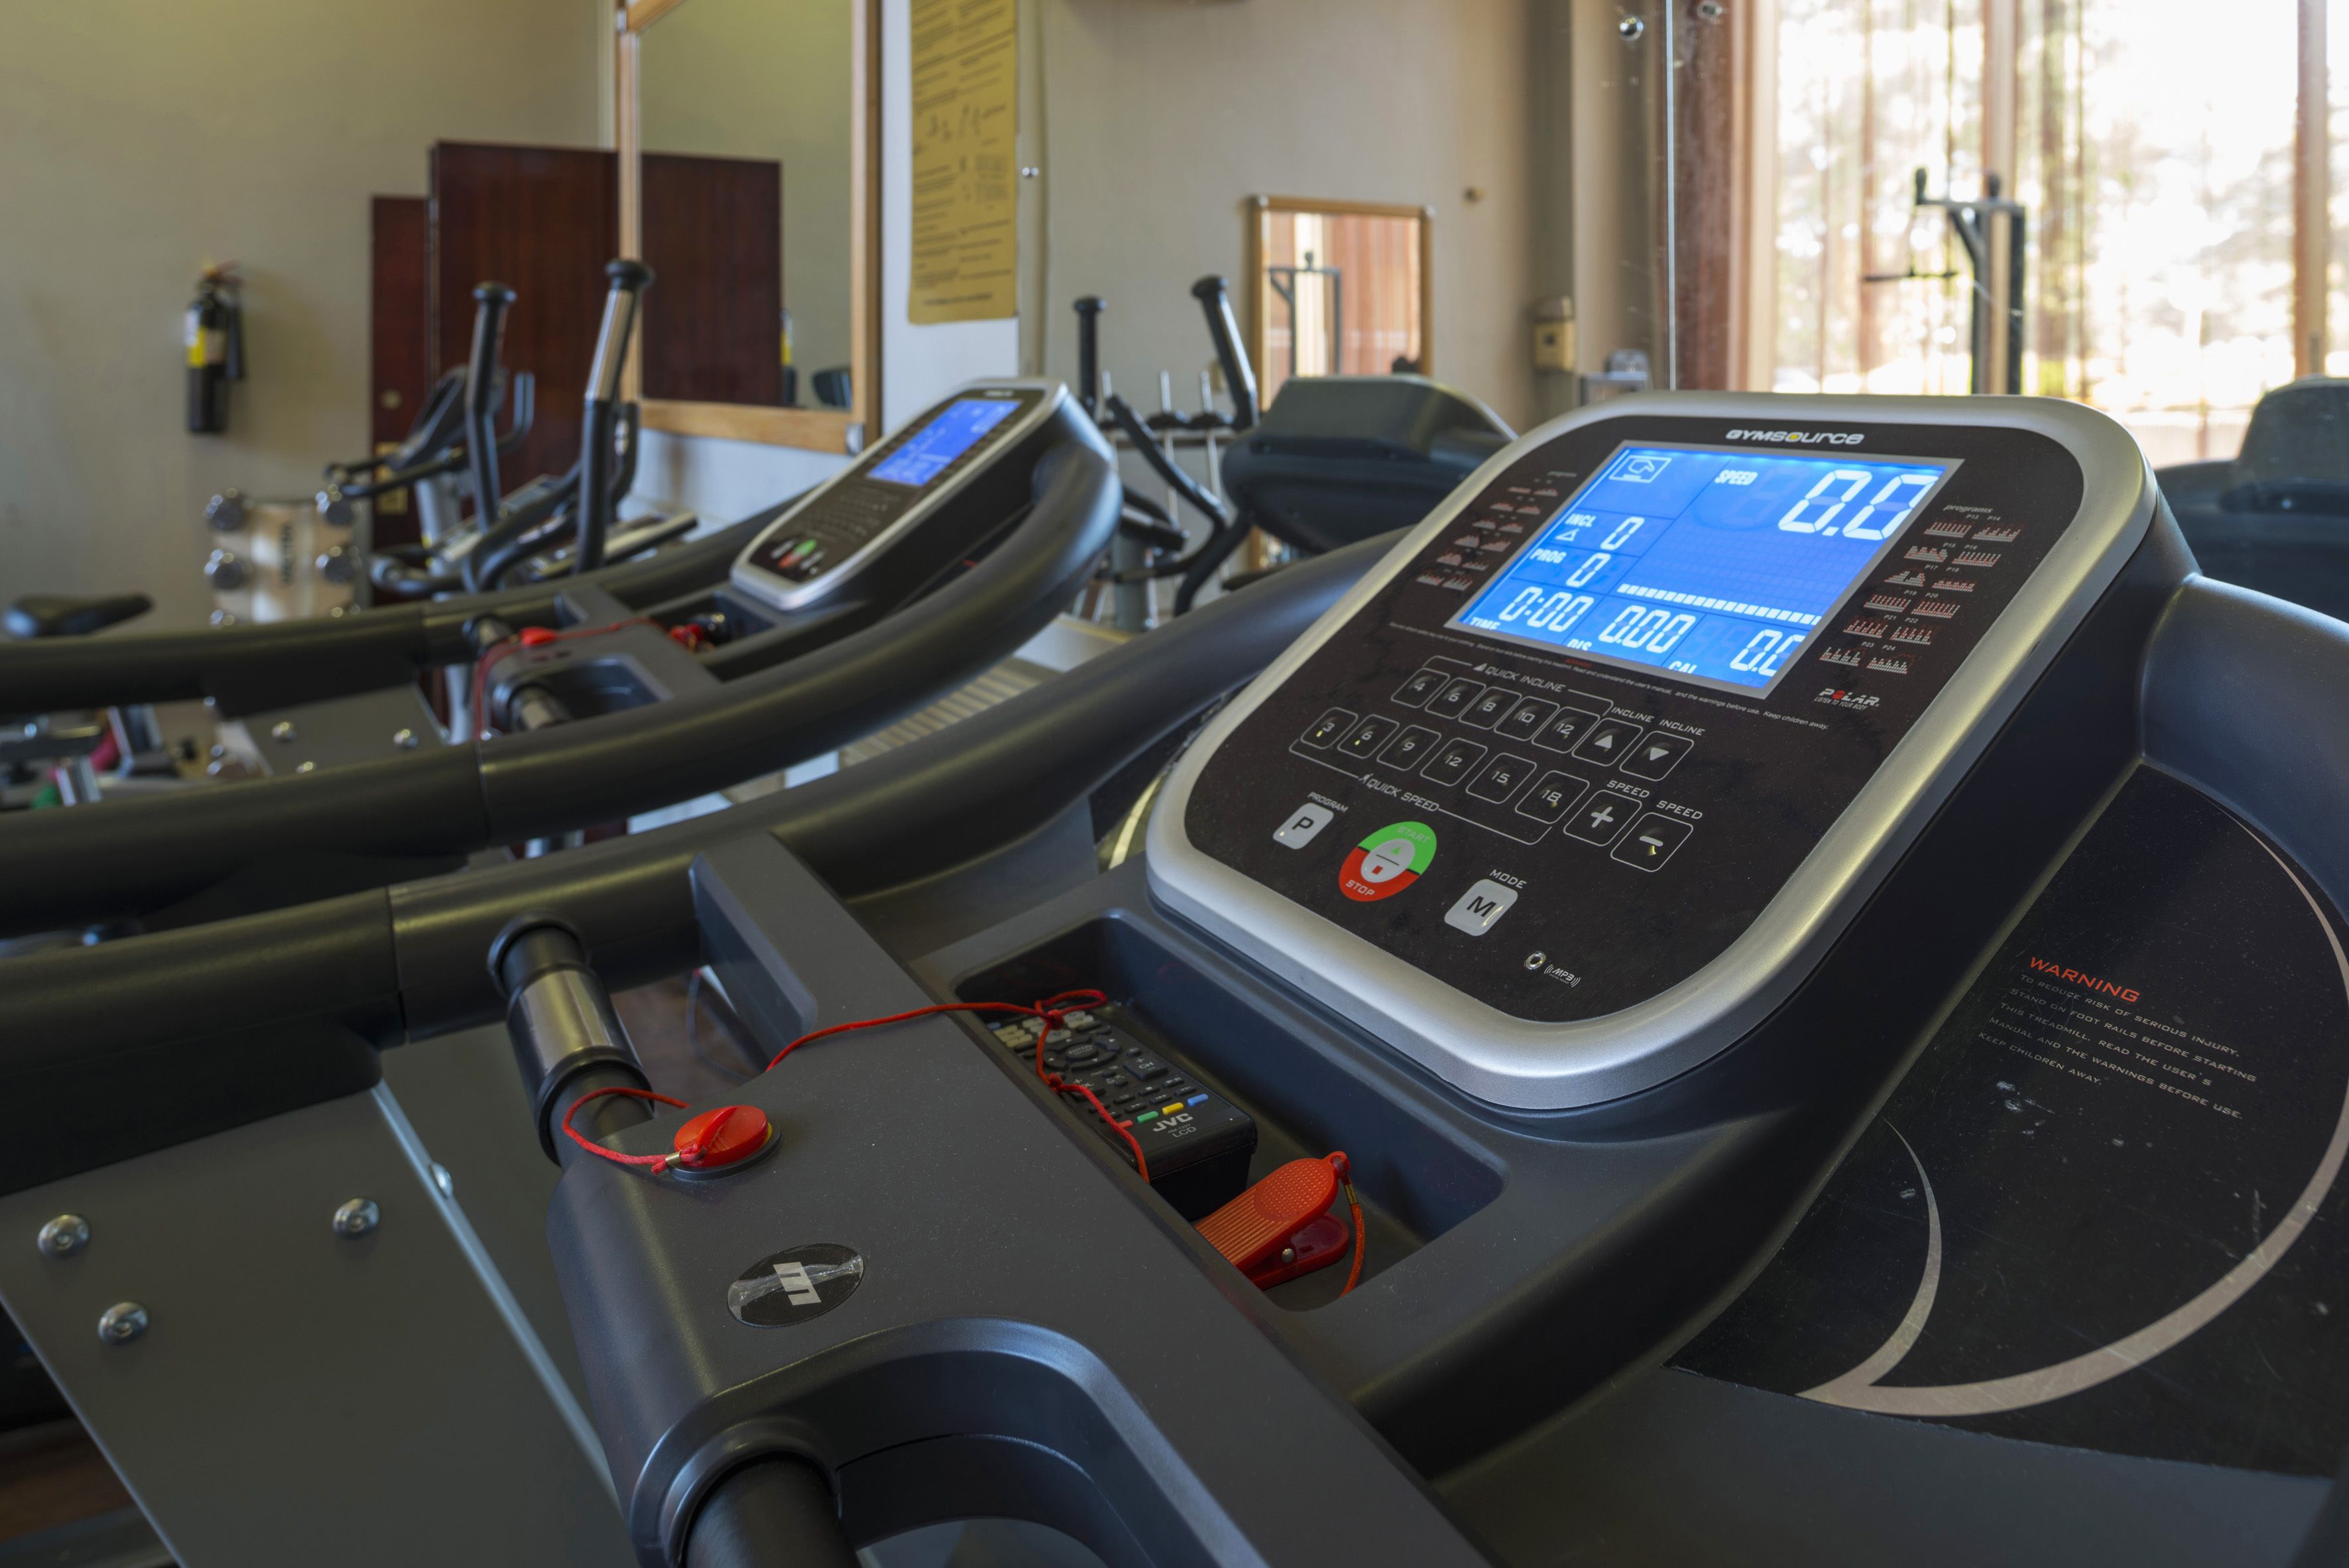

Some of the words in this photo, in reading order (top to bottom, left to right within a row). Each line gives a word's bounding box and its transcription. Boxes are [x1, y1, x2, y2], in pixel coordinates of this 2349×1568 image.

[1715, 469, 1758, 485] SPEED
[1943, 505, 1993, 513] programs
[1565, 513, 1596, 528] INCL
[1530, 548, 1567, 564] PROG
[1498, 586, 1595, 633] 0:00
[1470, 617, 1501, 630] TIME
[1598, 605, 1696, 654] 0.00
[1414, 682, 1425, 692] 4
[1485, 666, 1521, 682] QUICK
[1520, 675, 1567, 693] INCLINE
[1448, 692, 1461, 703] 6
[1482, 701, 1497, 713] 8
[1611, 706, 1654, 723] INCLINE
[1518, 711, 1536, 723] 10
[1763, 711, 1782, 721] Keep
[1781, 715, 1809, 726] children
[1809, 721, 1829, 731] away.
[1323, 722, 1335, 733] 3
[1555, 723, 1575, 735] 12
[1659, 719, 1706, 737] INCLINE
[1361, 731, 1374, 741] 6
[1402, 741, 1416, 752] 9
[1445, 754, 1463, 767] 12
[1491, 770, 1511, 784] 15
[1365, 778, 1402, 798] QUICK
[1400, 792, 1440, 812] SPEED
[1541, 789, 1562, 803] 18
[1606, 780, 1650, 798] SPEED
[1307, 792, 1349, 813] PROGRAM
[1656, 800, 1703, 820] SPEED
[1292, 816, 1314, 830] P
[1396, 826, 1431, 844] START
[1489, 869, 1528, 889] MODE
[1345, 880, 1376, 896] STOP
[1466, 895, 1497, 918] M
[1551, 968, 1575, 981] MP3
[2029, 956, 2141, 1003] WARNING
[2021, 974, 2034, 983] TO
[2037, 981, 2081, 1000] REDUCE
[2084, 998, 2112, 1011] RISK
[2115, 1008, 2132, 1017] OF
[2134, 1015, 2188, 1038] SERIOUS
[2191, 1035, 2240, 1057] INJURY.
[2000, 1002, 2024, 1016] THIS
[2029, 1013, 2090, 1041] TREADMILL.
[2098, 1039, 2130, 1055] READ
[2135, 1052, 2159, 1067] THE
[2010, 988, 2047, 1005] STAND
[2050, 1004, 2067, 1013] ON
[2070, 1010, 2102, 1025] FOOT
[2104, 1022, 2138, 1039] RAILS
[2141, 1036, 2190, 1058] BEFORE
[2193, 1054, 2258, 1083] STARTING
[1978, 1032, 2008, 1047] KEEP
[2009, 1044, 2065, 1071] CHILDREN
[2067, 1067, 2102, 1085] AWAY.
[1989, 1017, 2033, 1039] MANUAL
[2037, 1036, 2061, 1050] AND
[2065, 1046, 2089, 1060] THE
[2092, 1056, 2155, 1085] WARNINGS
[2157, 1082, 2209, 1106] BEFORE
[2212, 1103, 2243, 1120] USE.
[1152, 1113, 1193, 1132] JVC
[1172, 1126, 1197, 1138] LCD
